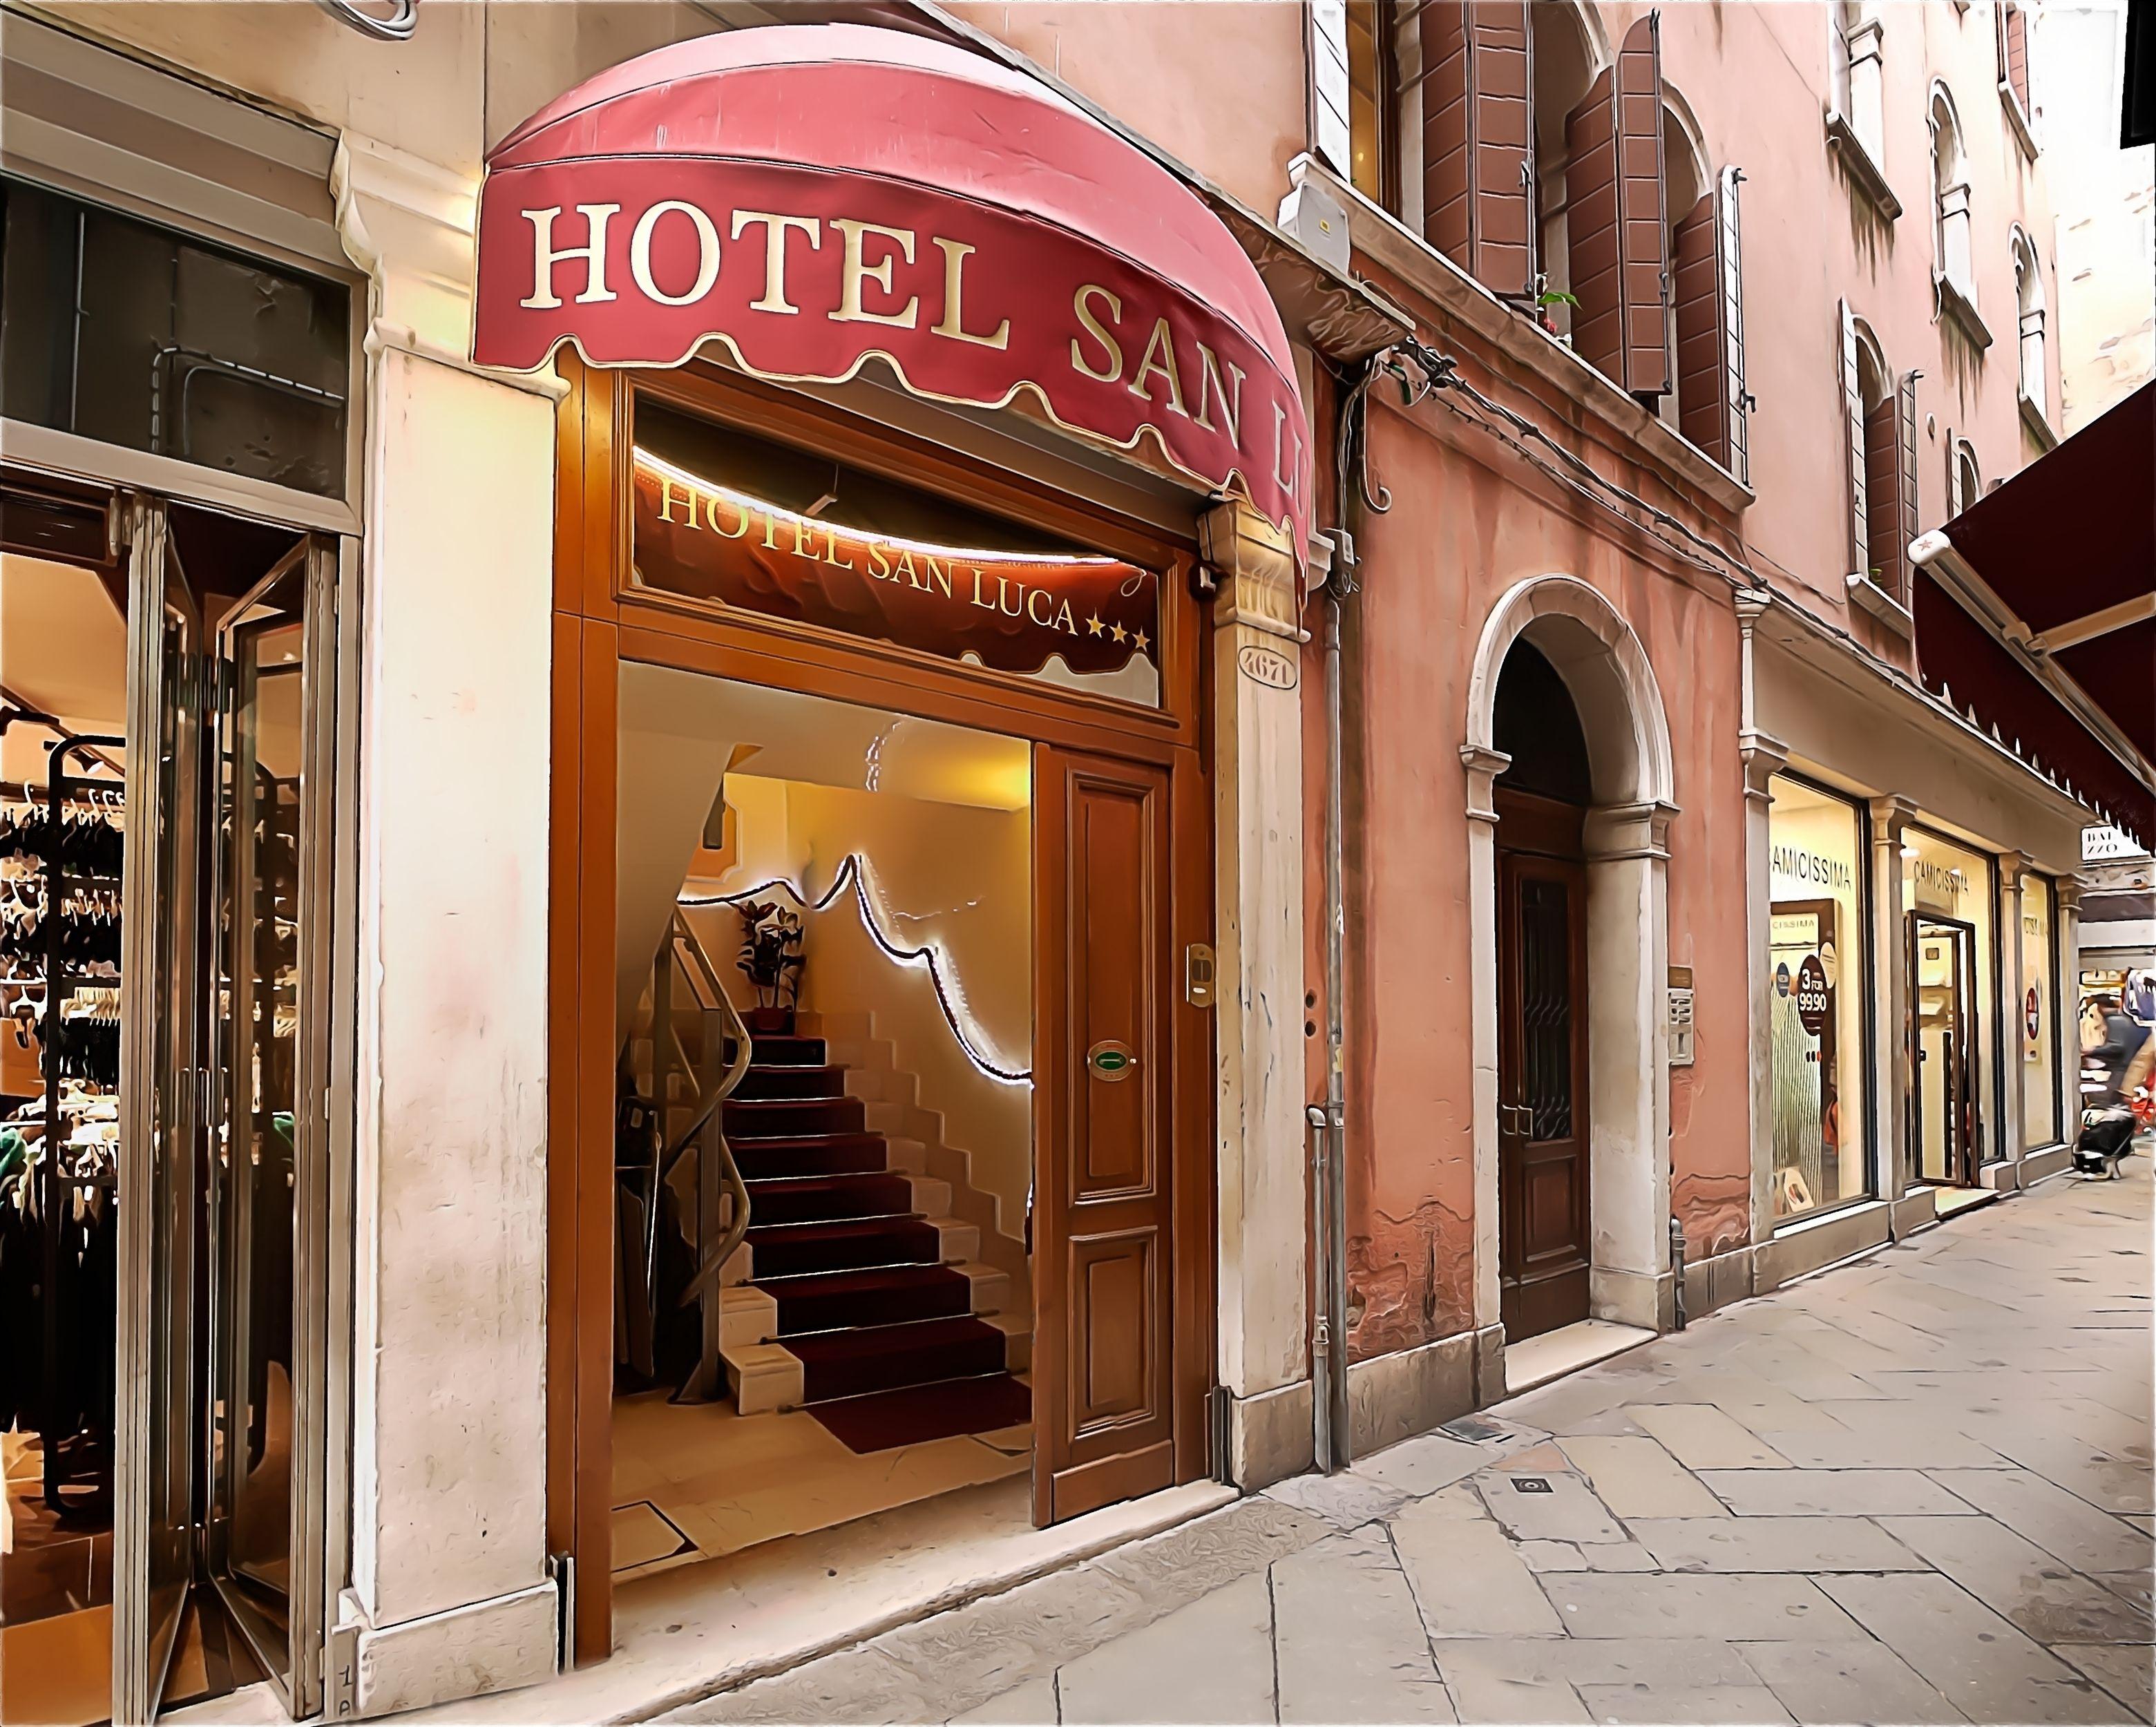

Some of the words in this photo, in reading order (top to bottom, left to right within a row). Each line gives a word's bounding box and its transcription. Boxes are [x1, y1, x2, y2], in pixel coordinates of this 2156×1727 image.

[520, 199, 1011, 351] HOTEL
[1071, 284, 1246, 451] SAN
[657, 475, 854, 569] HOTEL
[866, 540, 953, 600] SAN
[970, 568, 1079, 636] LUCA
[1245, 651, 1288, 685] 4671
[1772, 845, 1851, 892] AMICISSIMA
[1772, 919, 1815, 929] CISSIMA
[1802, 969, 1811, 990] 3
